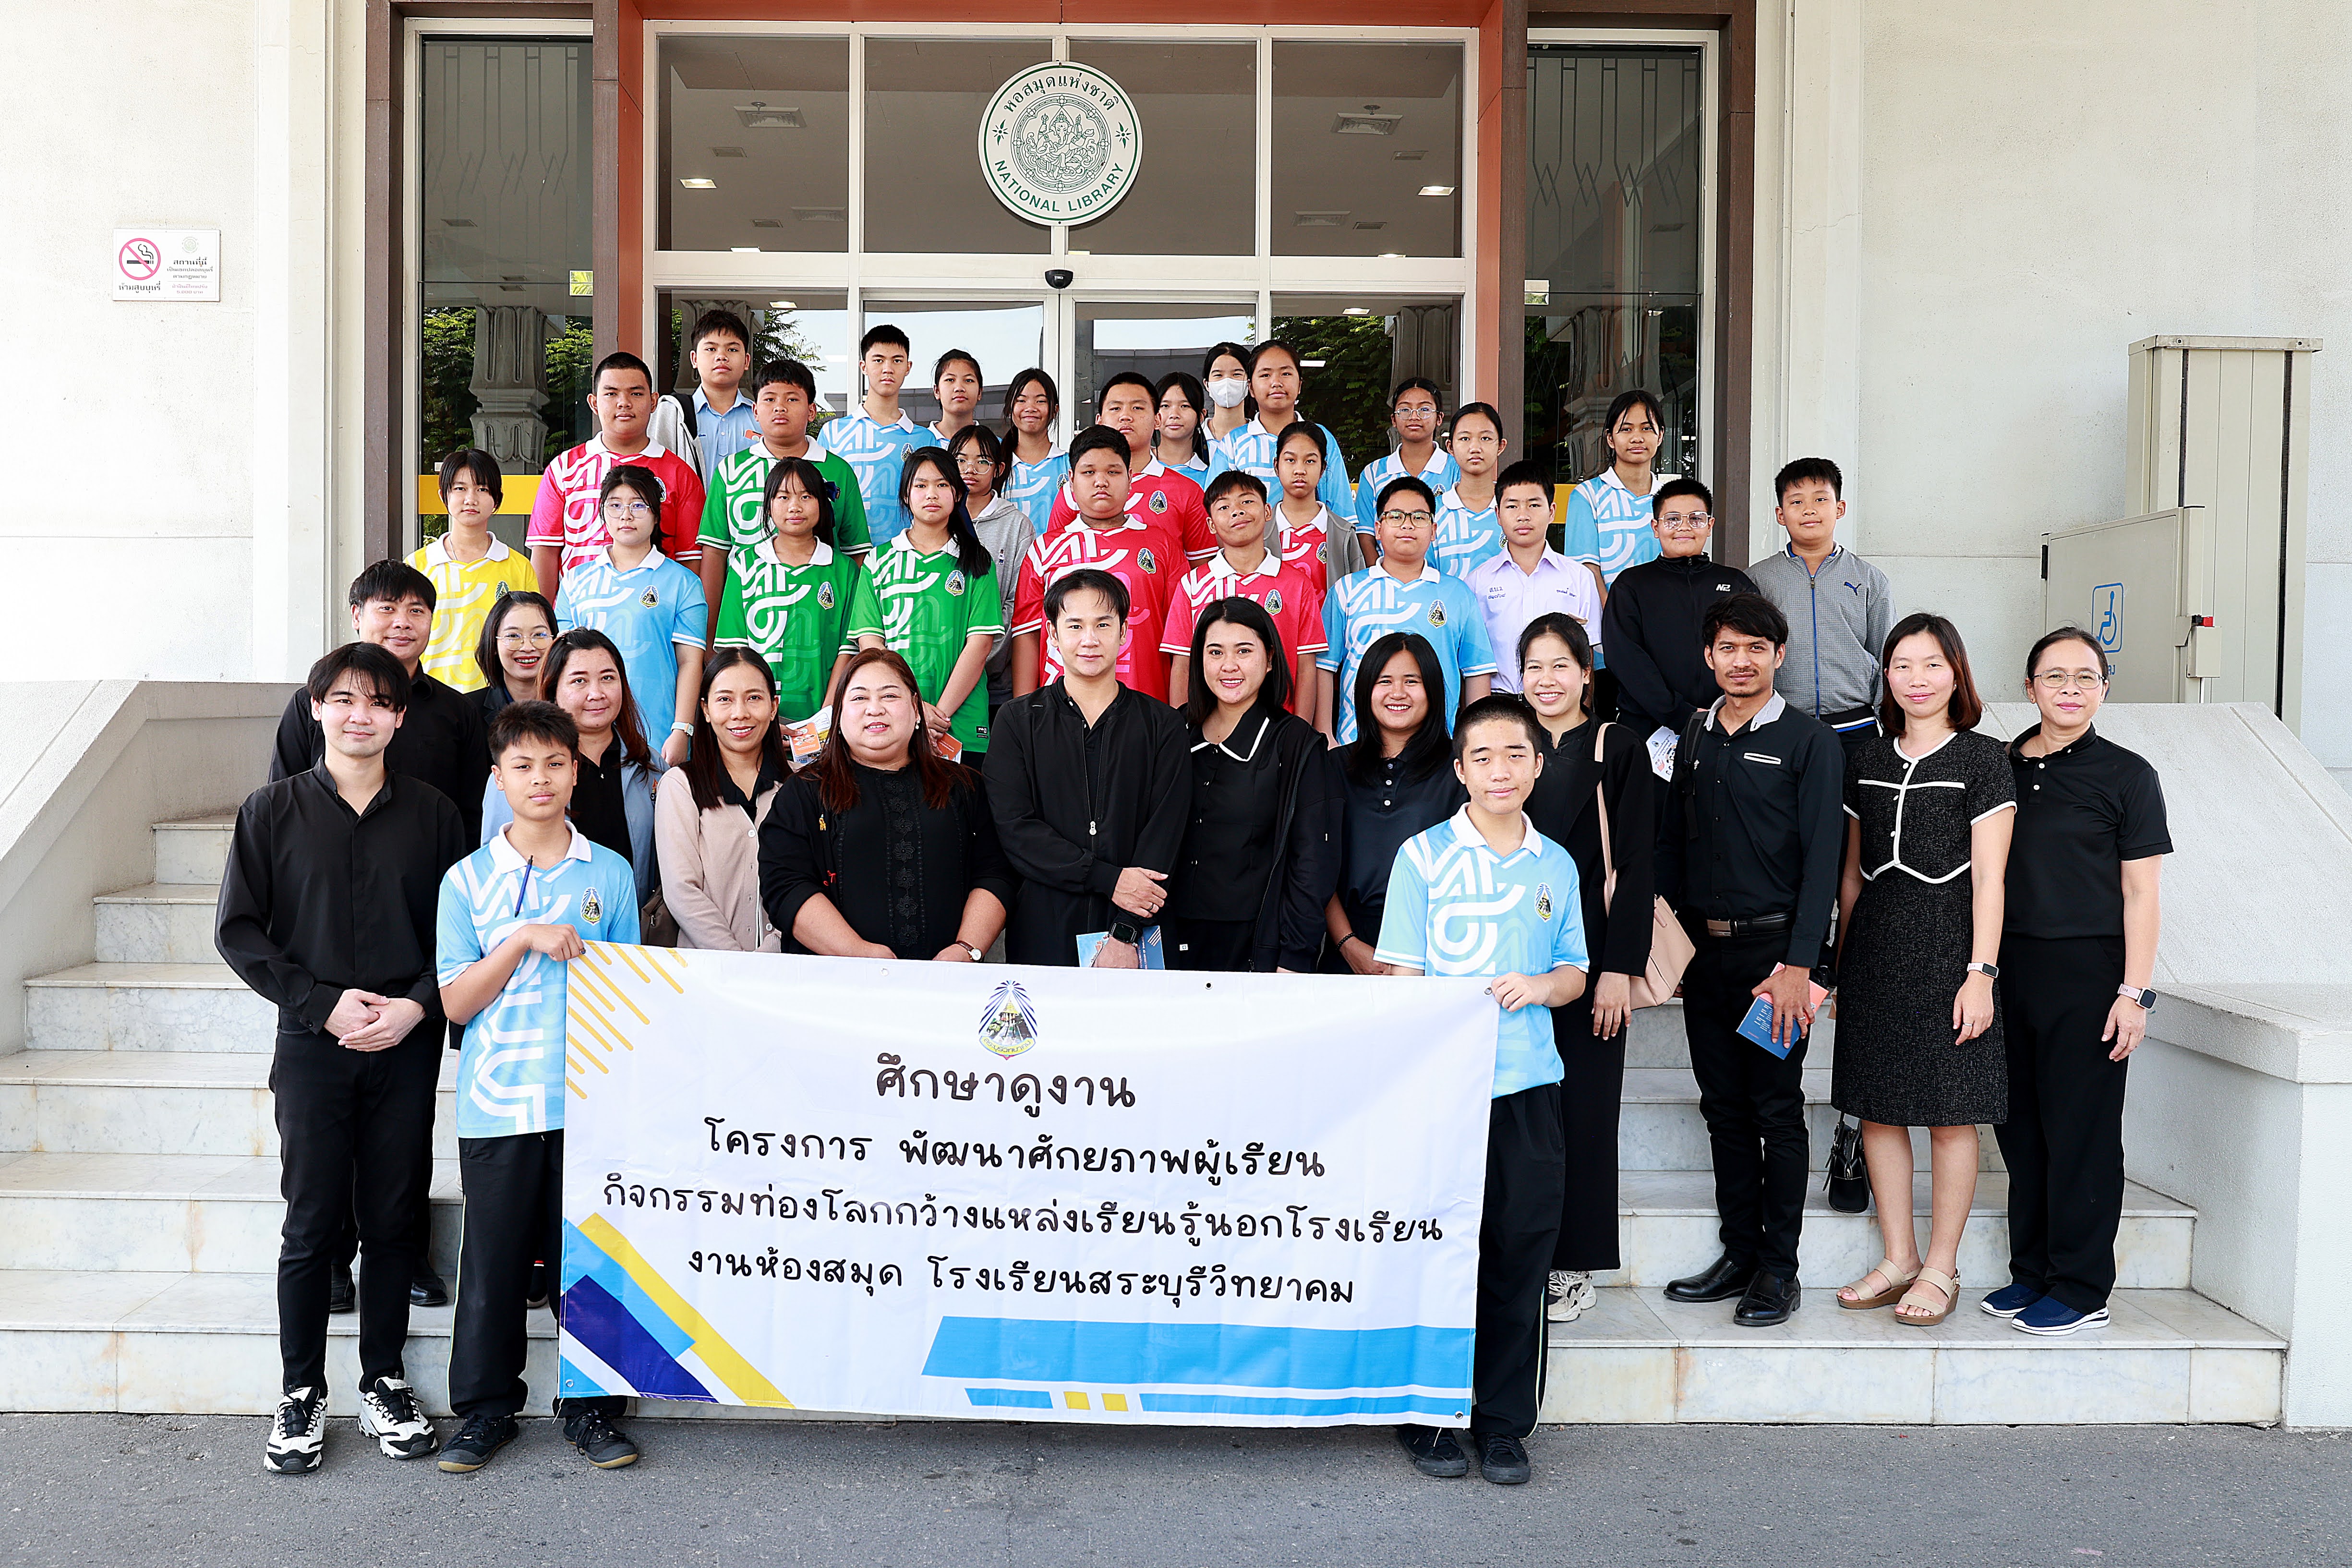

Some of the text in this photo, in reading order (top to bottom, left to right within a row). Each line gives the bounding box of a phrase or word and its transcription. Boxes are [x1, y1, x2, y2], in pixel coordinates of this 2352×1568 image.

[1003, 72, 1120, 113] หอสมุดแห่งชาติ
[994, 159, 1124, 212] NATIONAL LIBRARY
[119, 281, 161, 293] ห้ามสูบบุหรี่
[876, 1052, 1136, 1118] ศึกษาดูงาน
[703, 1116, 1325, 1186] โครงการ พัฒนาศักยภาพผู้เรียน
[603, 1172, 1443, 1248] กิจกรรมท่องโลกกว้างแหล่งเรียนรู้นอกโรงเรียน
[688, 1246, 1353, 1309] งานห้องสมุด โรงเรียนสระบุรีวิทยาคม
